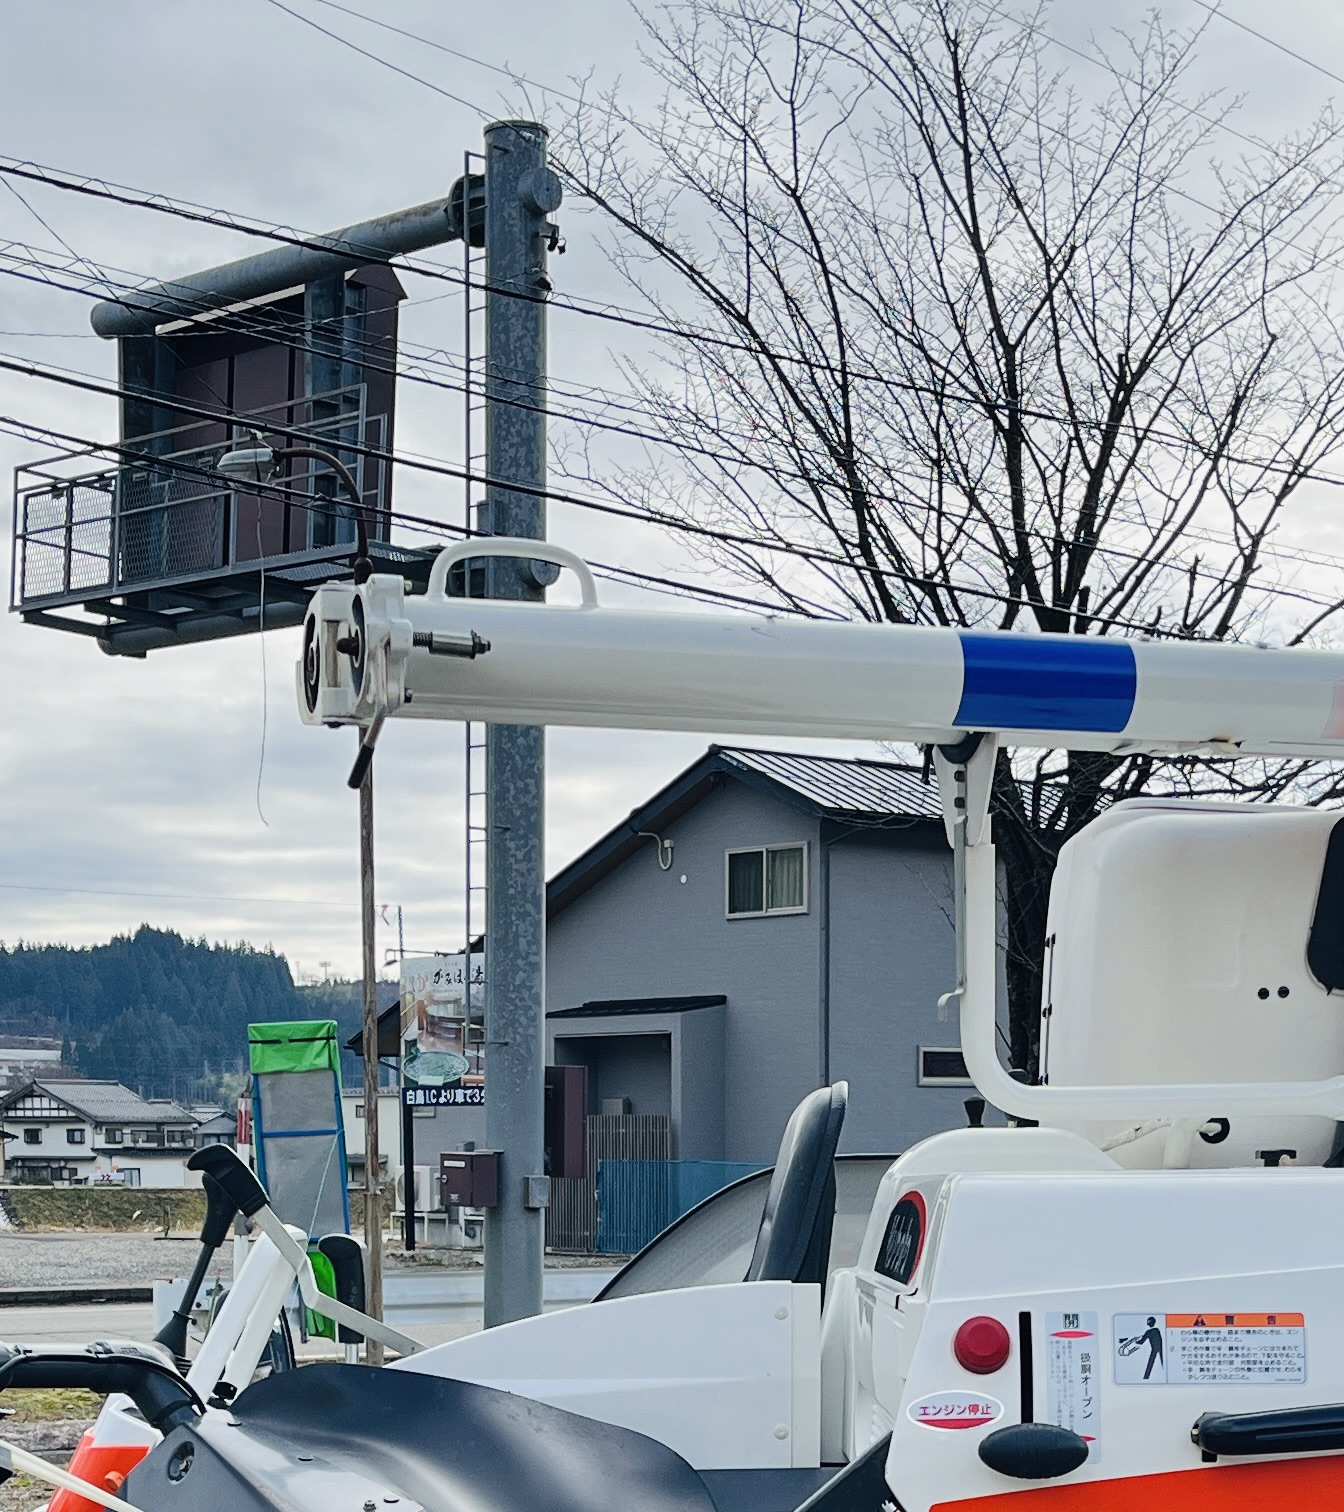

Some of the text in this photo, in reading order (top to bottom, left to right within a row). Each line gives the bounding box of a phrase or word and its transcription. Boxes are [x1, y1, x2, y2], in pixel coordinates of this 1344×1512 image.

[1063, 1313, 1079, 1329] 開
[919, 1403, 992, 1416] エンジン停止
